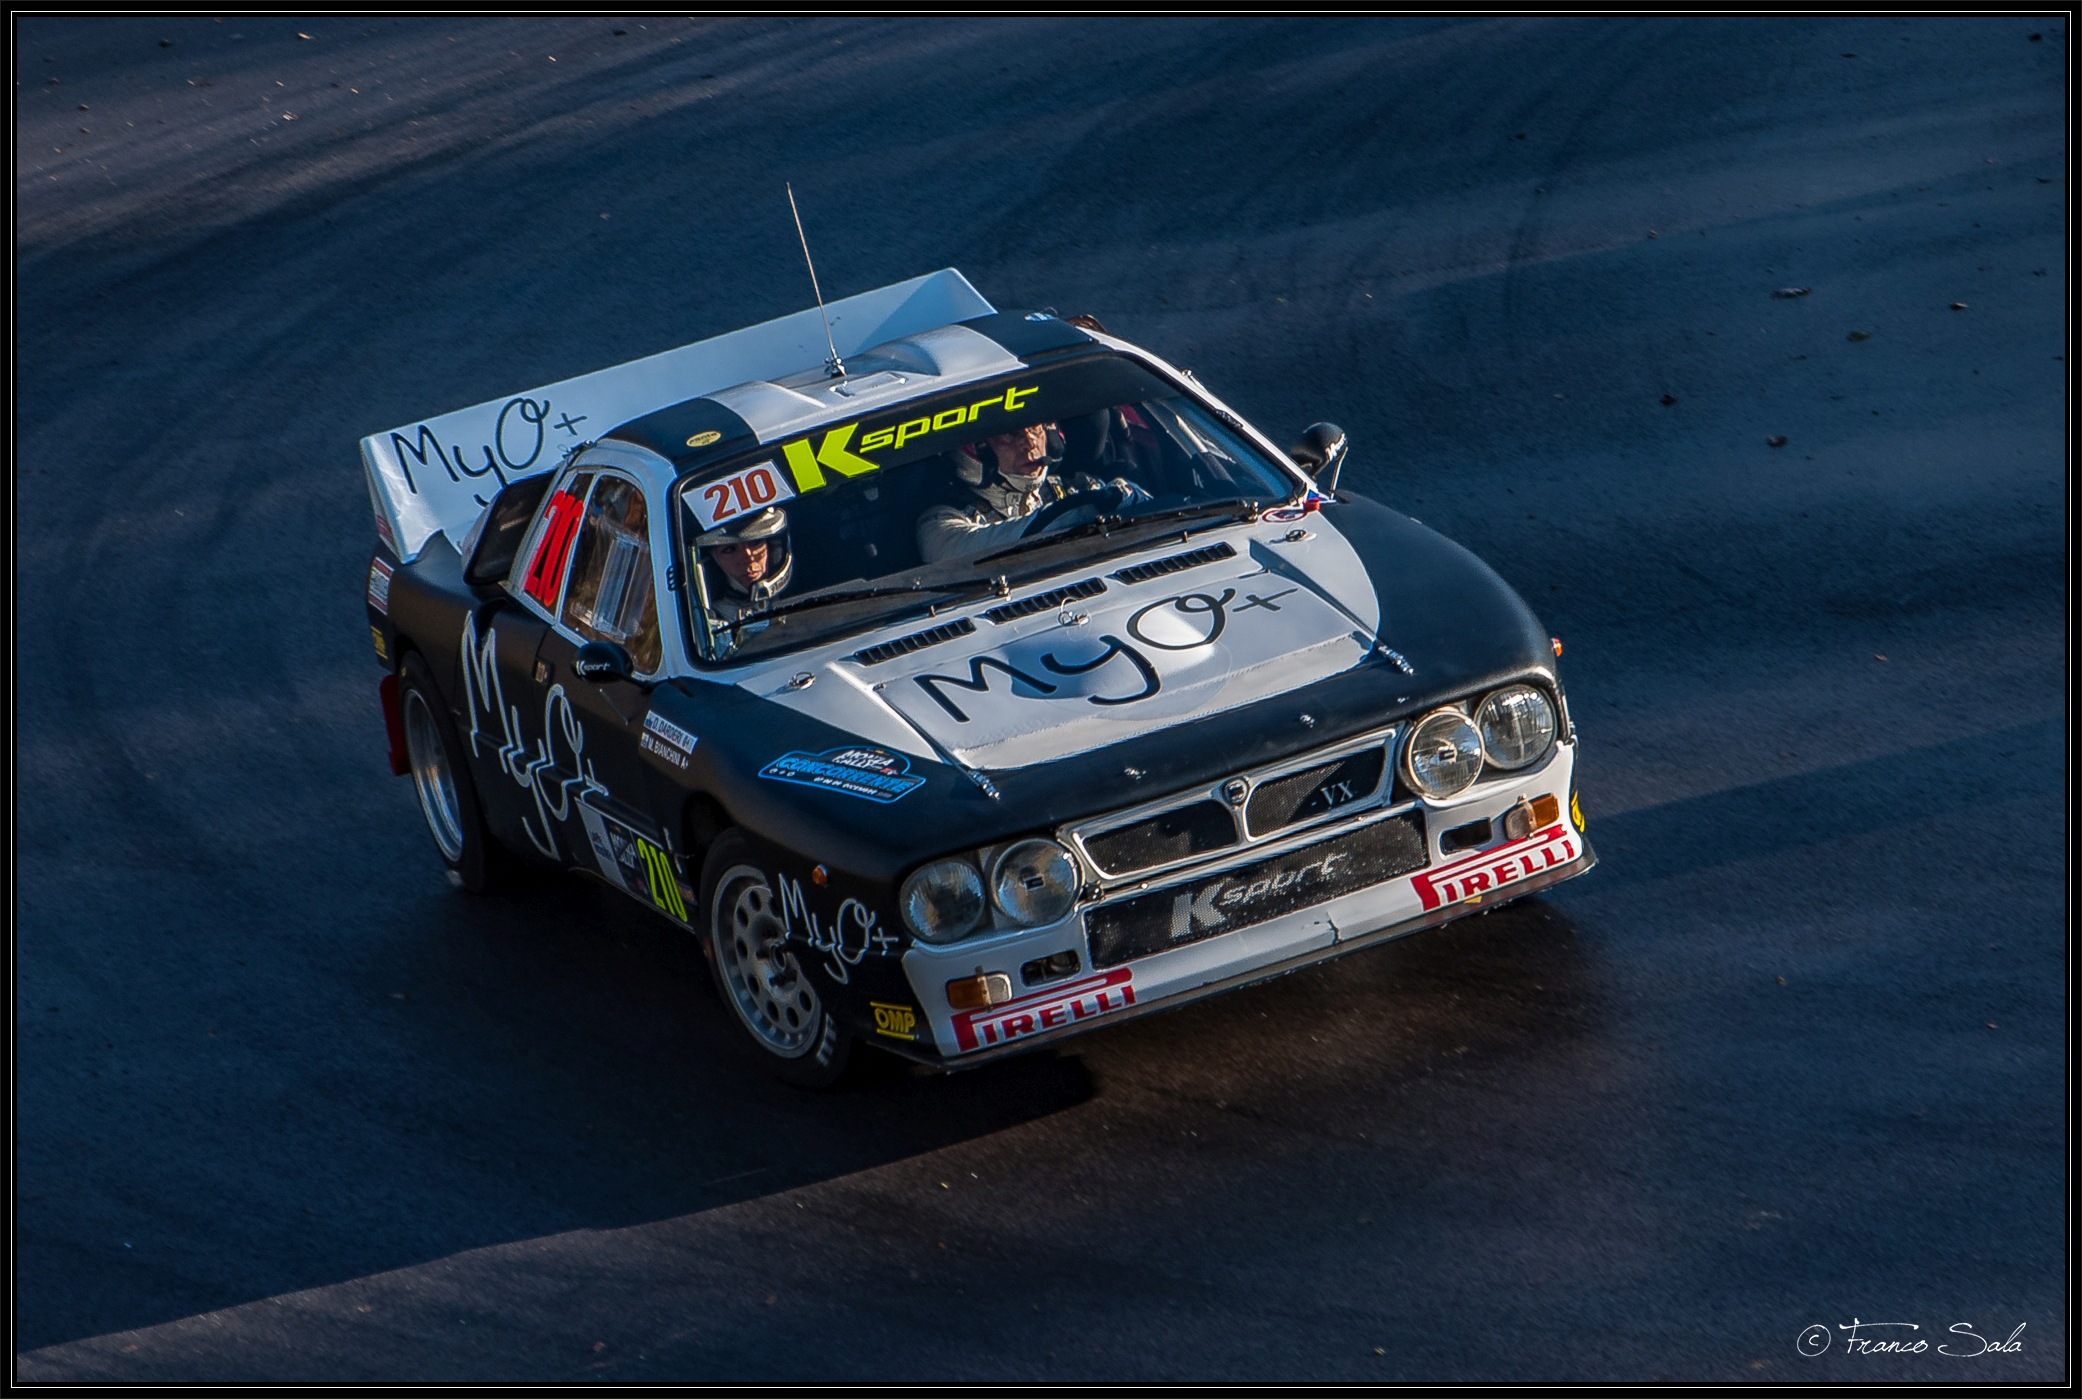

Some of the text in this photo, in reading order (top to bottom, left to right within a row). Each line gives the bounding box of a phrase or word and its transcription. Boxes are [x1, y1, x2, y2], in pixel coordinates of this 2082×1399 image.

[703, 468, 777, 523] 210
[522, 488, 584, 607] 210
[776, 756, 914, 793] CONCORRENTE
[1321, 779, 1355, 808] VX
[637, 838, 688, 923] 210
[1410, 823, 1576, 912] PIRELLI
[873, 1006, 917, 1035] OMP
[949, 967, 1138, 1053] PIRELLI
